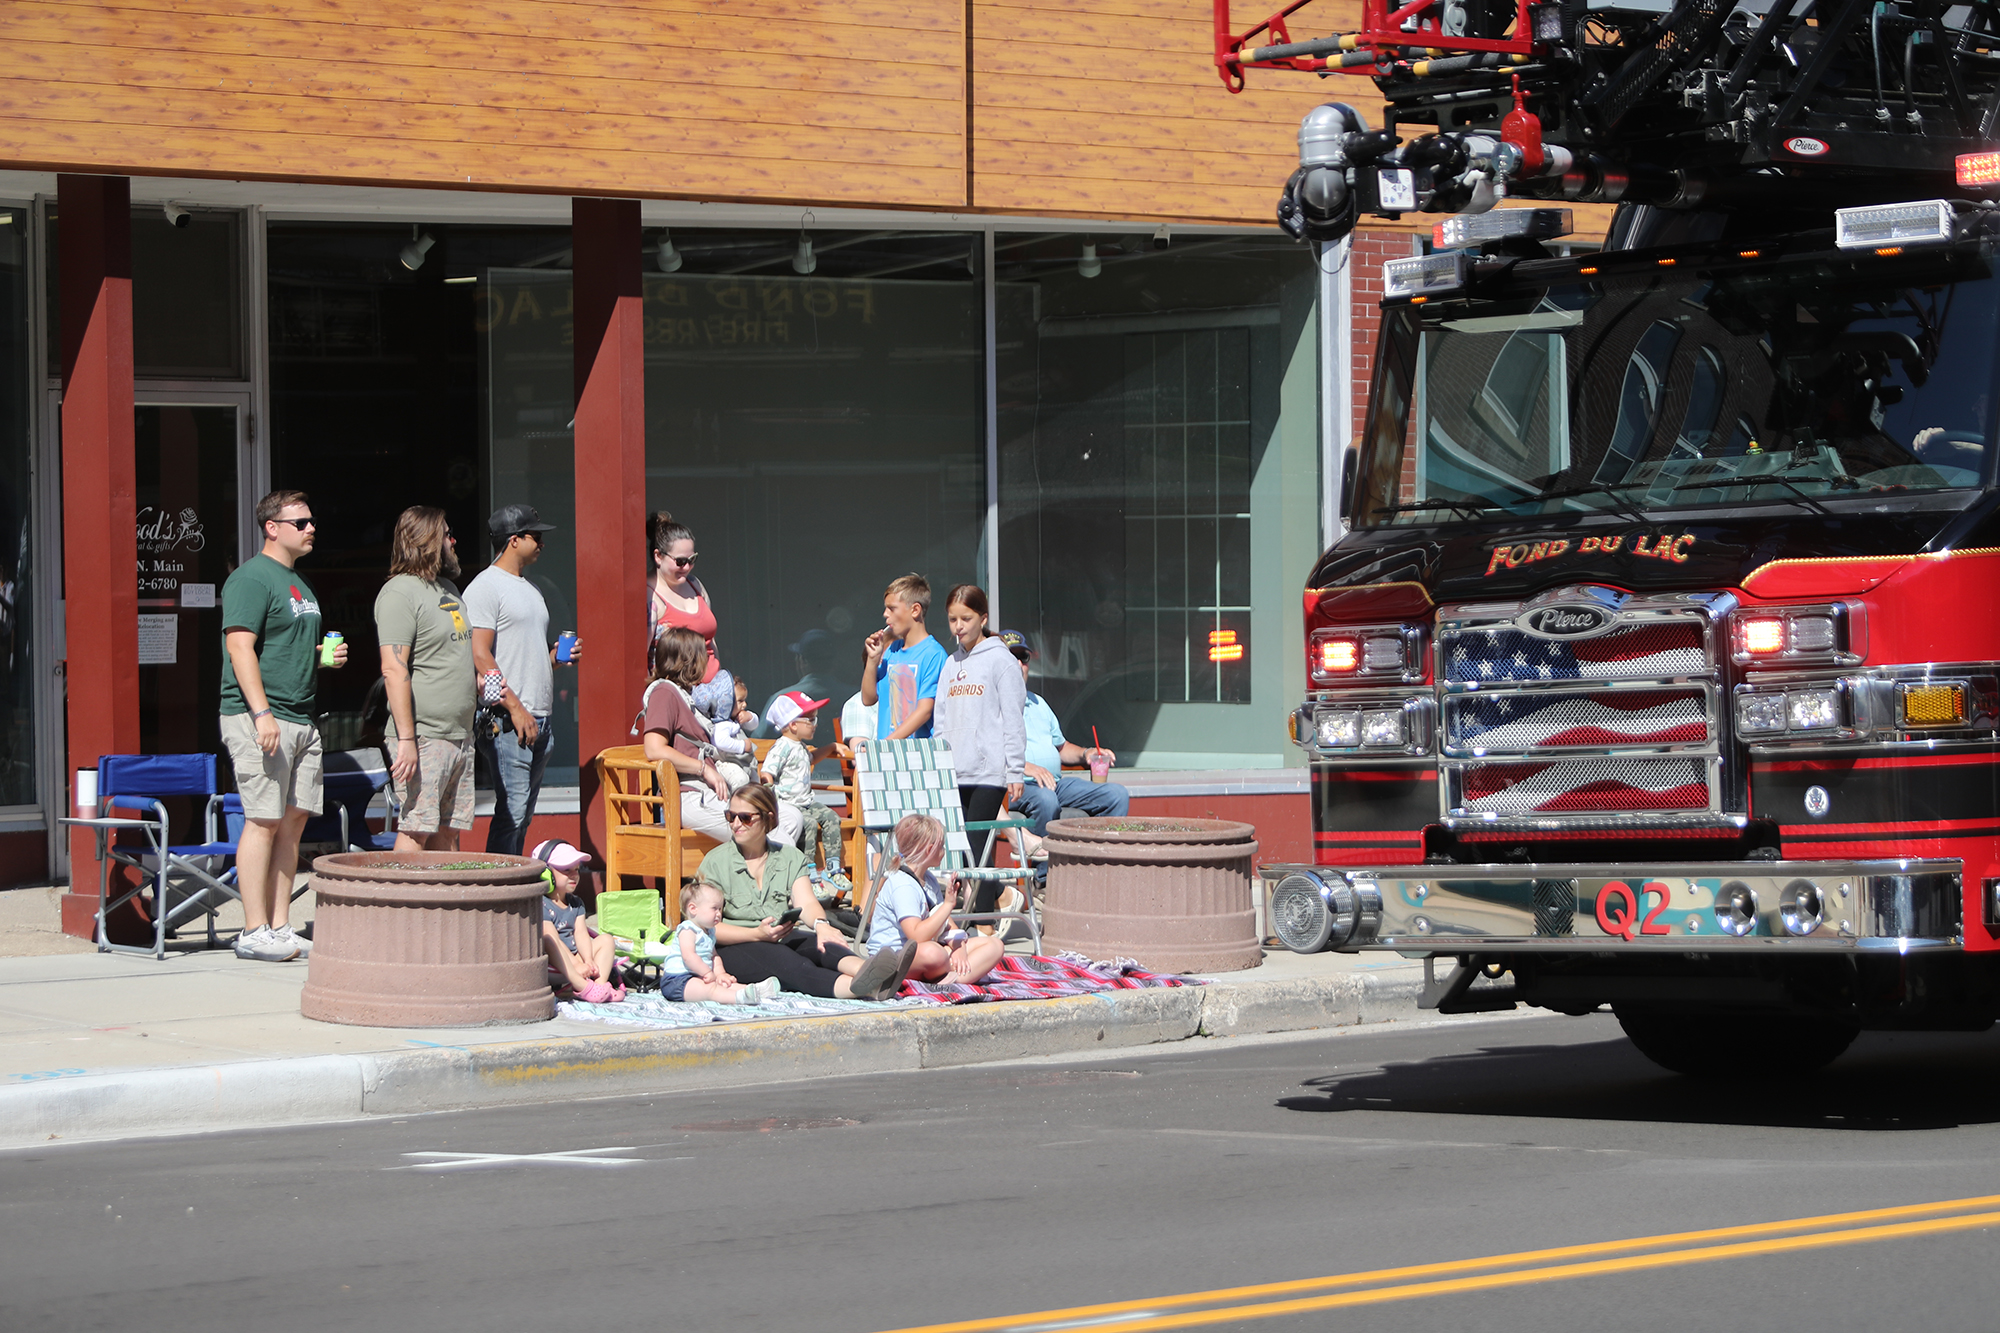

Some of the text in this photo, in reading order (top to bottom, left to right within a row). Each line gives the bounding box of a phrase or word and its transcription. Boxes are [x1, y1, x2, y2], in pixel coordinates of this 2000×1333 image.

[1794, 138, 1818, 151] Pierce
[1484, 533, 1697, 577] FOND DU LAC
[153, 560, 184, 572] Main
[138, 578, 177, 590] 2-6780
[1540, 608, 1594, 631] Pierce
[947, 684, 985, 698] ARBIRDS
[1594, 880, 1671, 942] Q2
